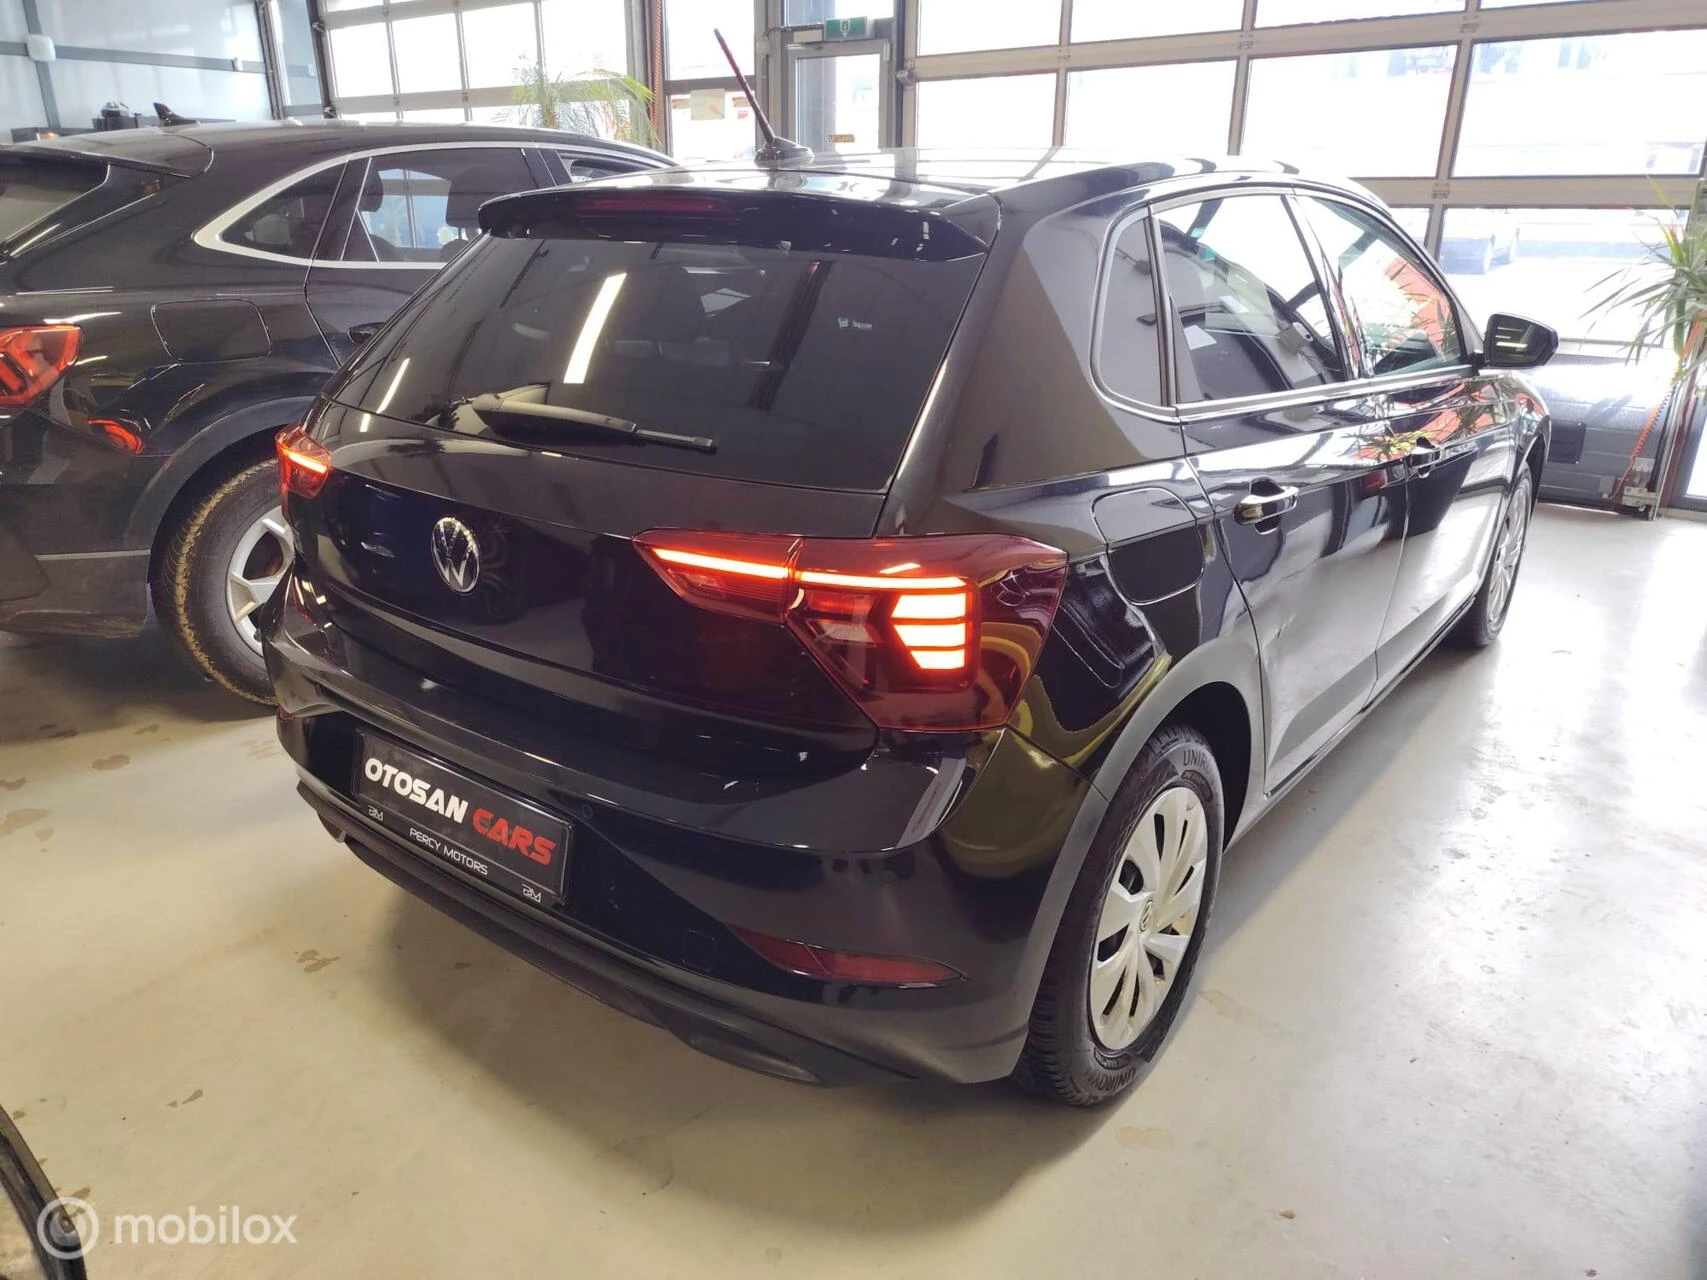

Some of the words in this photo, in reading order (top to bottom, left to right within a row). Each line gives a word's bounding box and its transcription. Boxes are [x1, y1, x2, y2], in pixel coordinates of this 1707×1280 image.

[364, 757, 469, 824] OTOSAN
[472, 807, 557, 866] CARS
[409, 827, 442, 851] PERCY
[443, 845, 488, 876] MOTORS
